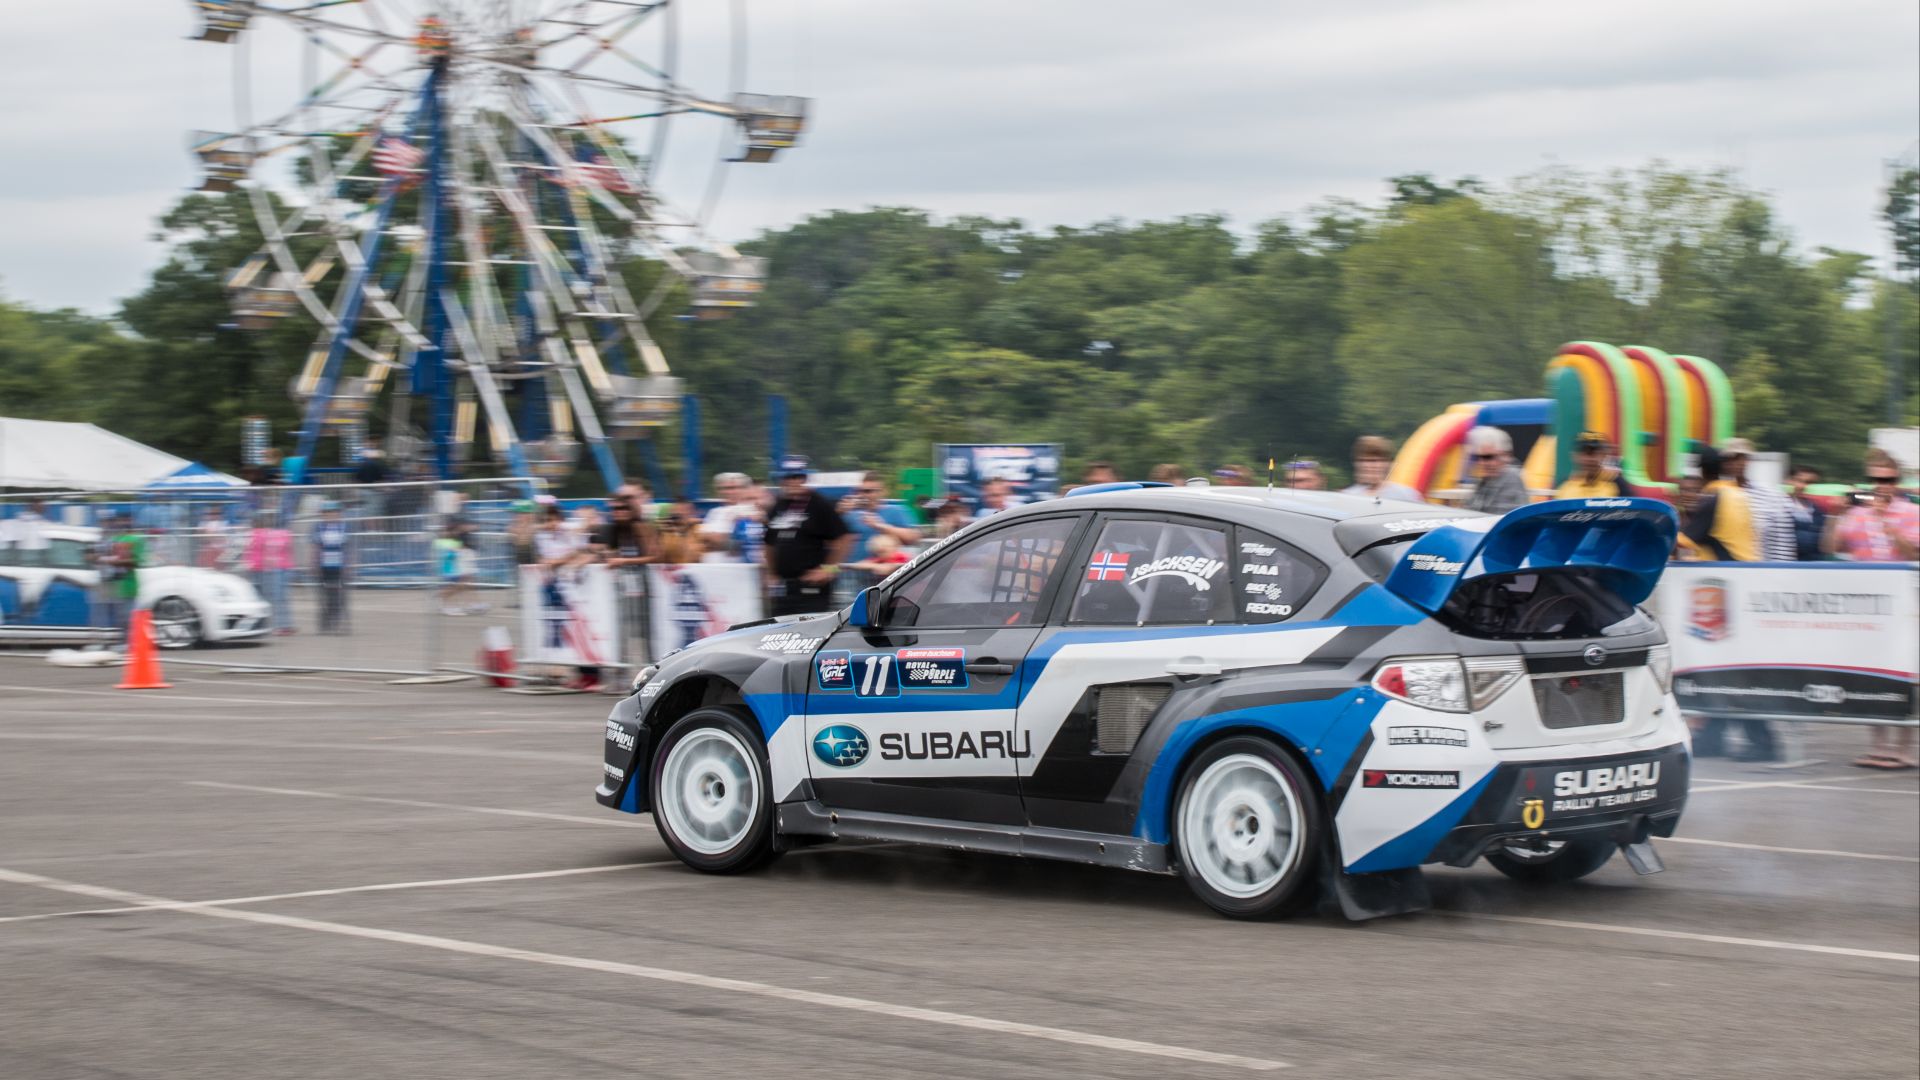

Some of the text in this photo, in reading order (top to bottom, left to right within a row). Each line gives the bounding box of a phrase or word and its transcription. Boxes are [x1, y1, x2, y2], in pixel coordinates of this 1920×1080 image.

[1130, 555, 1225, 580] ISACHSEN
[1241, 563, 1279, 576] PIAA
[1245, 602, 1293, 616] RECARO
[760, 632, 793, 642] ROYAL
[776, 637, 821, 650] PURPLE
[905, 661, 931, 669] ROYAL
[861, 655, 891, 696] 11
[922, 668, 957, 680] PURPLE
[879, 729, 1031, 761] SUBARU
[1384, 773, 1458, 787] YOKOHAMA
[1553, 760, 1661, 797] SUBARU
[1552, 798, 1596, 812] RALLY
[1598, 792, 1633, 807] TEAM
